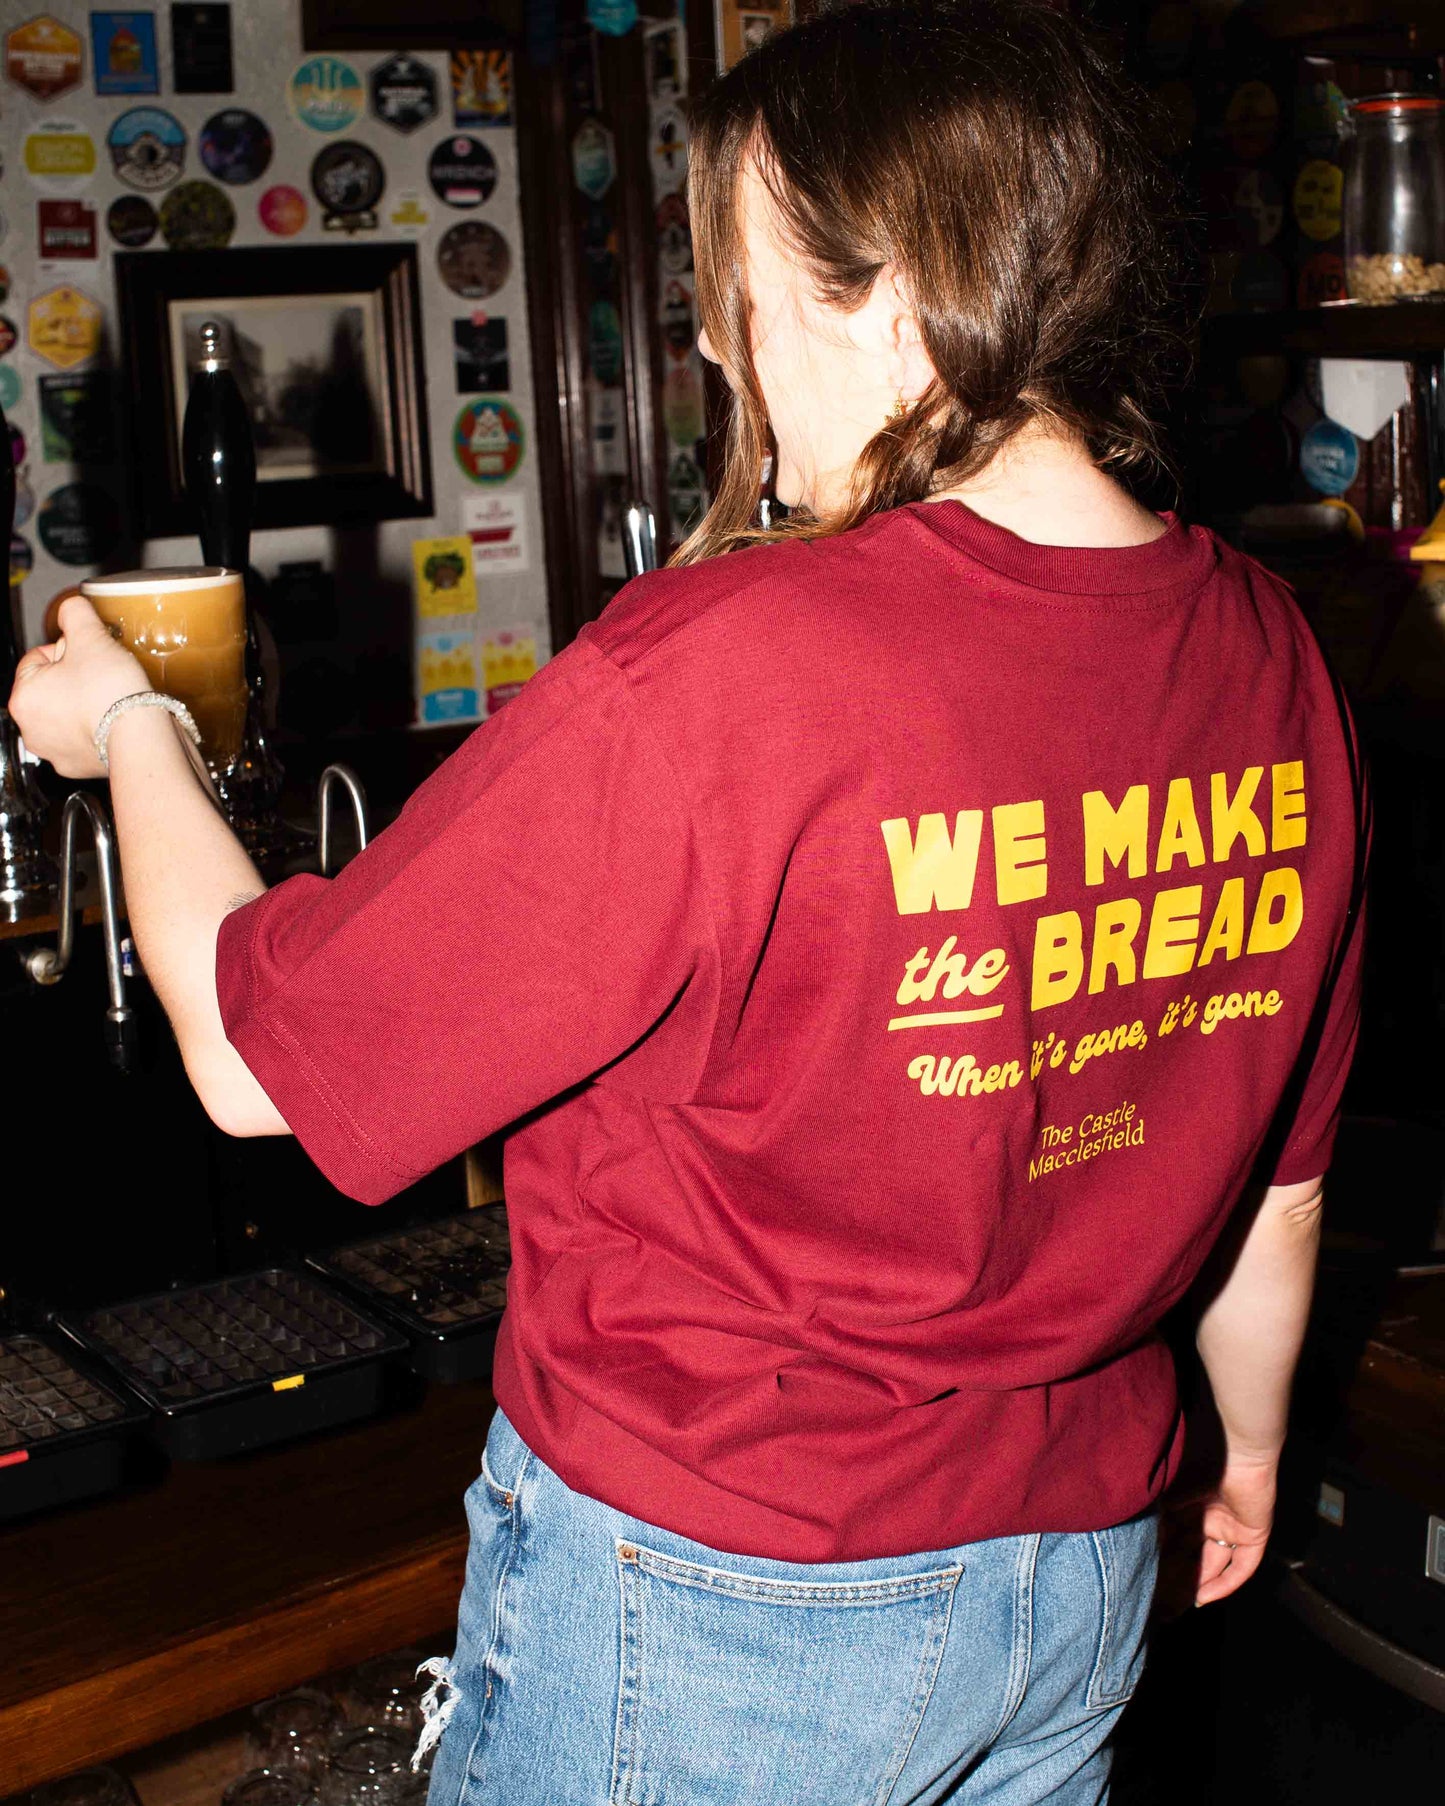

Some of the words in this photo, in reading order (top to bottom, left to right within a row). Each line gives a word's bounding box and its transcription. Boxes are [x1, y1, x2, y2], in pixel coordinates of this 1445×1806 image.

[881, 800, 1048, 915] WE
[1082, 760, 1307, 887] MAKE
[896, 935, 1011, 1005] the
[1031, 867, 1304, 1012] BREAD
[907, 1054, 1024, 1097] When
[1030, 1032, 1067, 1080] it's
[1069, 1019, 1148, 1075] gone,
[1158, 995, 1198, 1037] it's
[1199, 989, 1284, 1035] gone
[1028, 1119, 1146, 1183] Macclesfield
[1042, 1124, 1074, 1149] The
[1079, 1101, 1136, 1138] Castle
